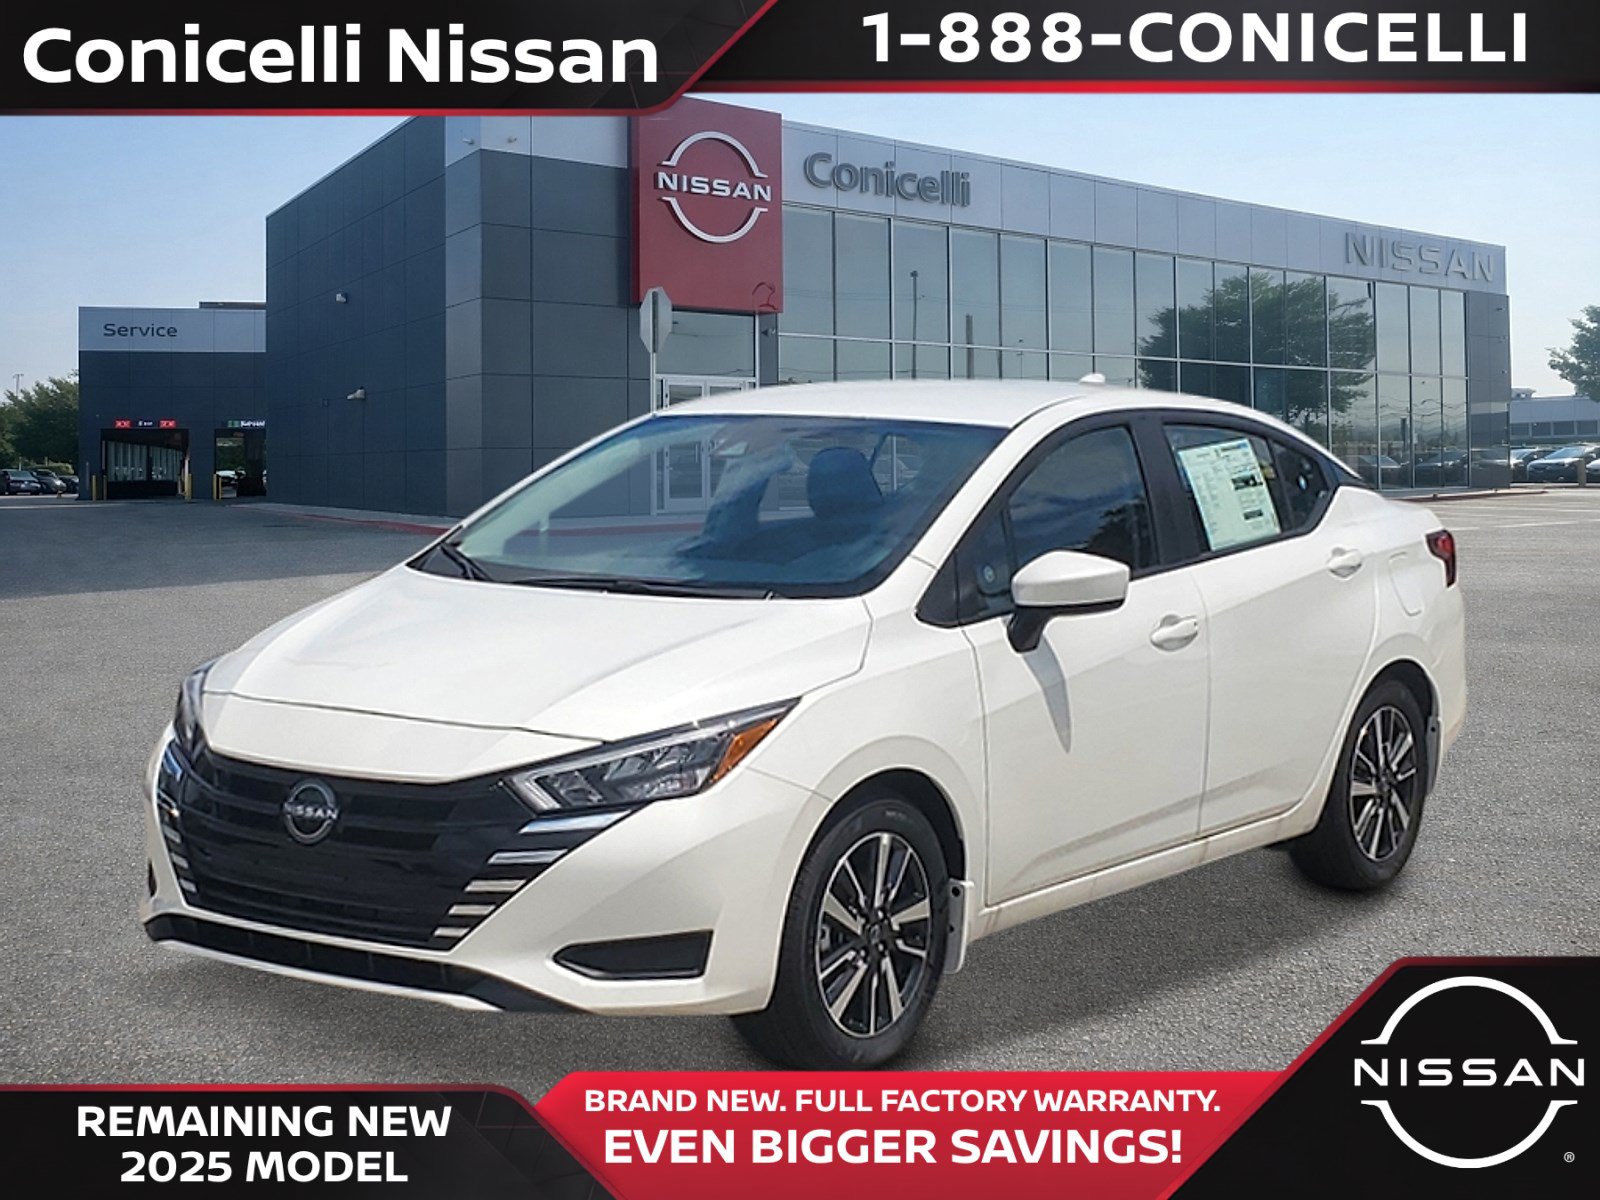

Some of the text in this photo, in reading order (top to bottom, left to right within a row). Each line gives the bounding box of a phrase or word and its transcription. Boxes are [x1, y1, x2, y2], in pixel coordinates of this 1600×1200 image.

[655, 171, 772, 202] NISSAN
[804, 151, 970, 206] Conicelli
[1345, 232, 1495, 281] NISSAN
[103, 323, 178, 338] Service
